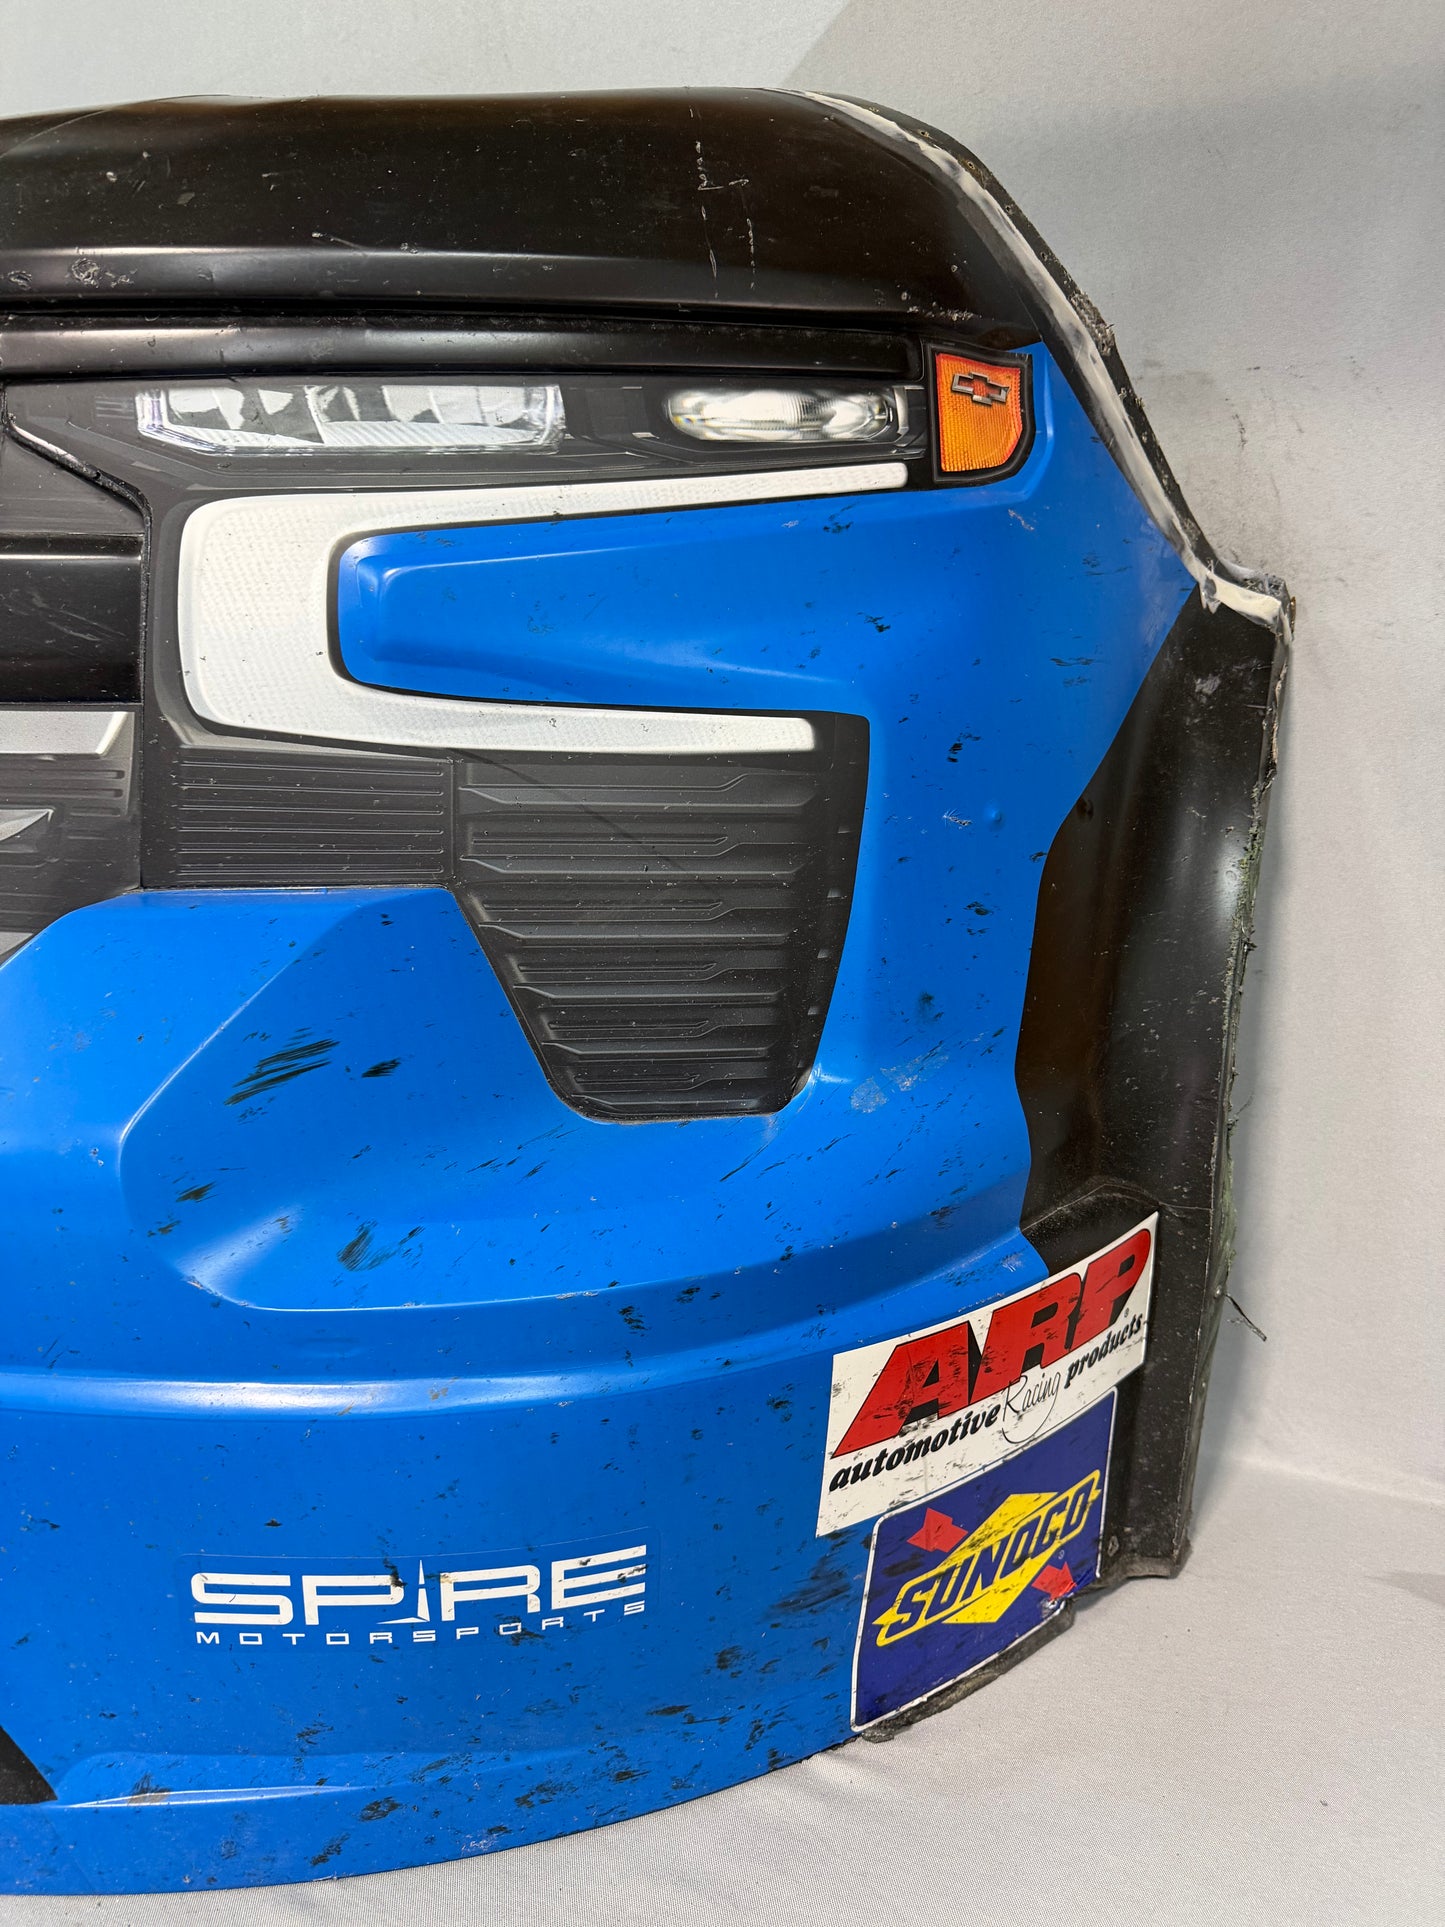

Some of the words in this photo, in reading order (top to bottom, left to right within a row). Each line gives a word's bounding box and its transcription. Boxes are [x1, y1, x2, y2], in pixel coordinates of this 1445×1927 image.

[829, 1406, 1001, 1491] automotive
[1001, 1372, 1061, 1444] Racing
[1064, 1313, 1143, 1389] products
[832, 1228, 1151, 1458] ARP
[191, 1544, 646, 1625] SPIRE
[196, 1601, 645, 1645] MOTORSPORTS
[881, 1473, 1097, 1640] SUNOCO
